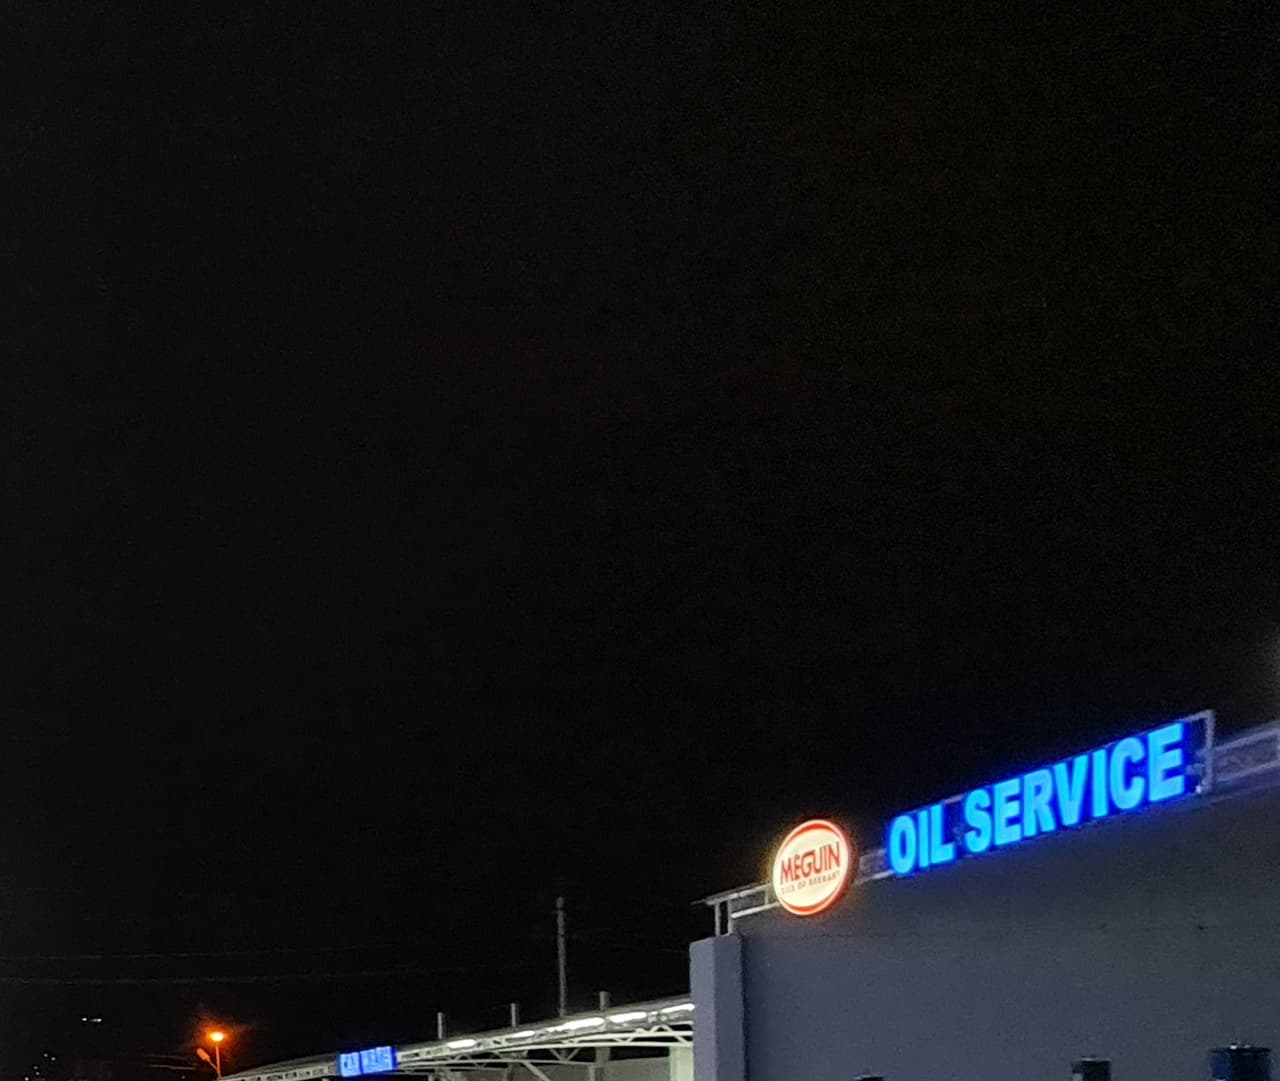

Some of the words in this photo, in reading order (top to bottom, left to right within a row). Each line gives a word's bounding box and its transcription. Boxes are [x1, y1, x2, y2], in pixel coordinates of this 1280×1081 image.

[890, 804, 955, 874] OIL
[963, 722, 1185, 853] SERVICE
[780, 841, 841, 885] MEGUIN
